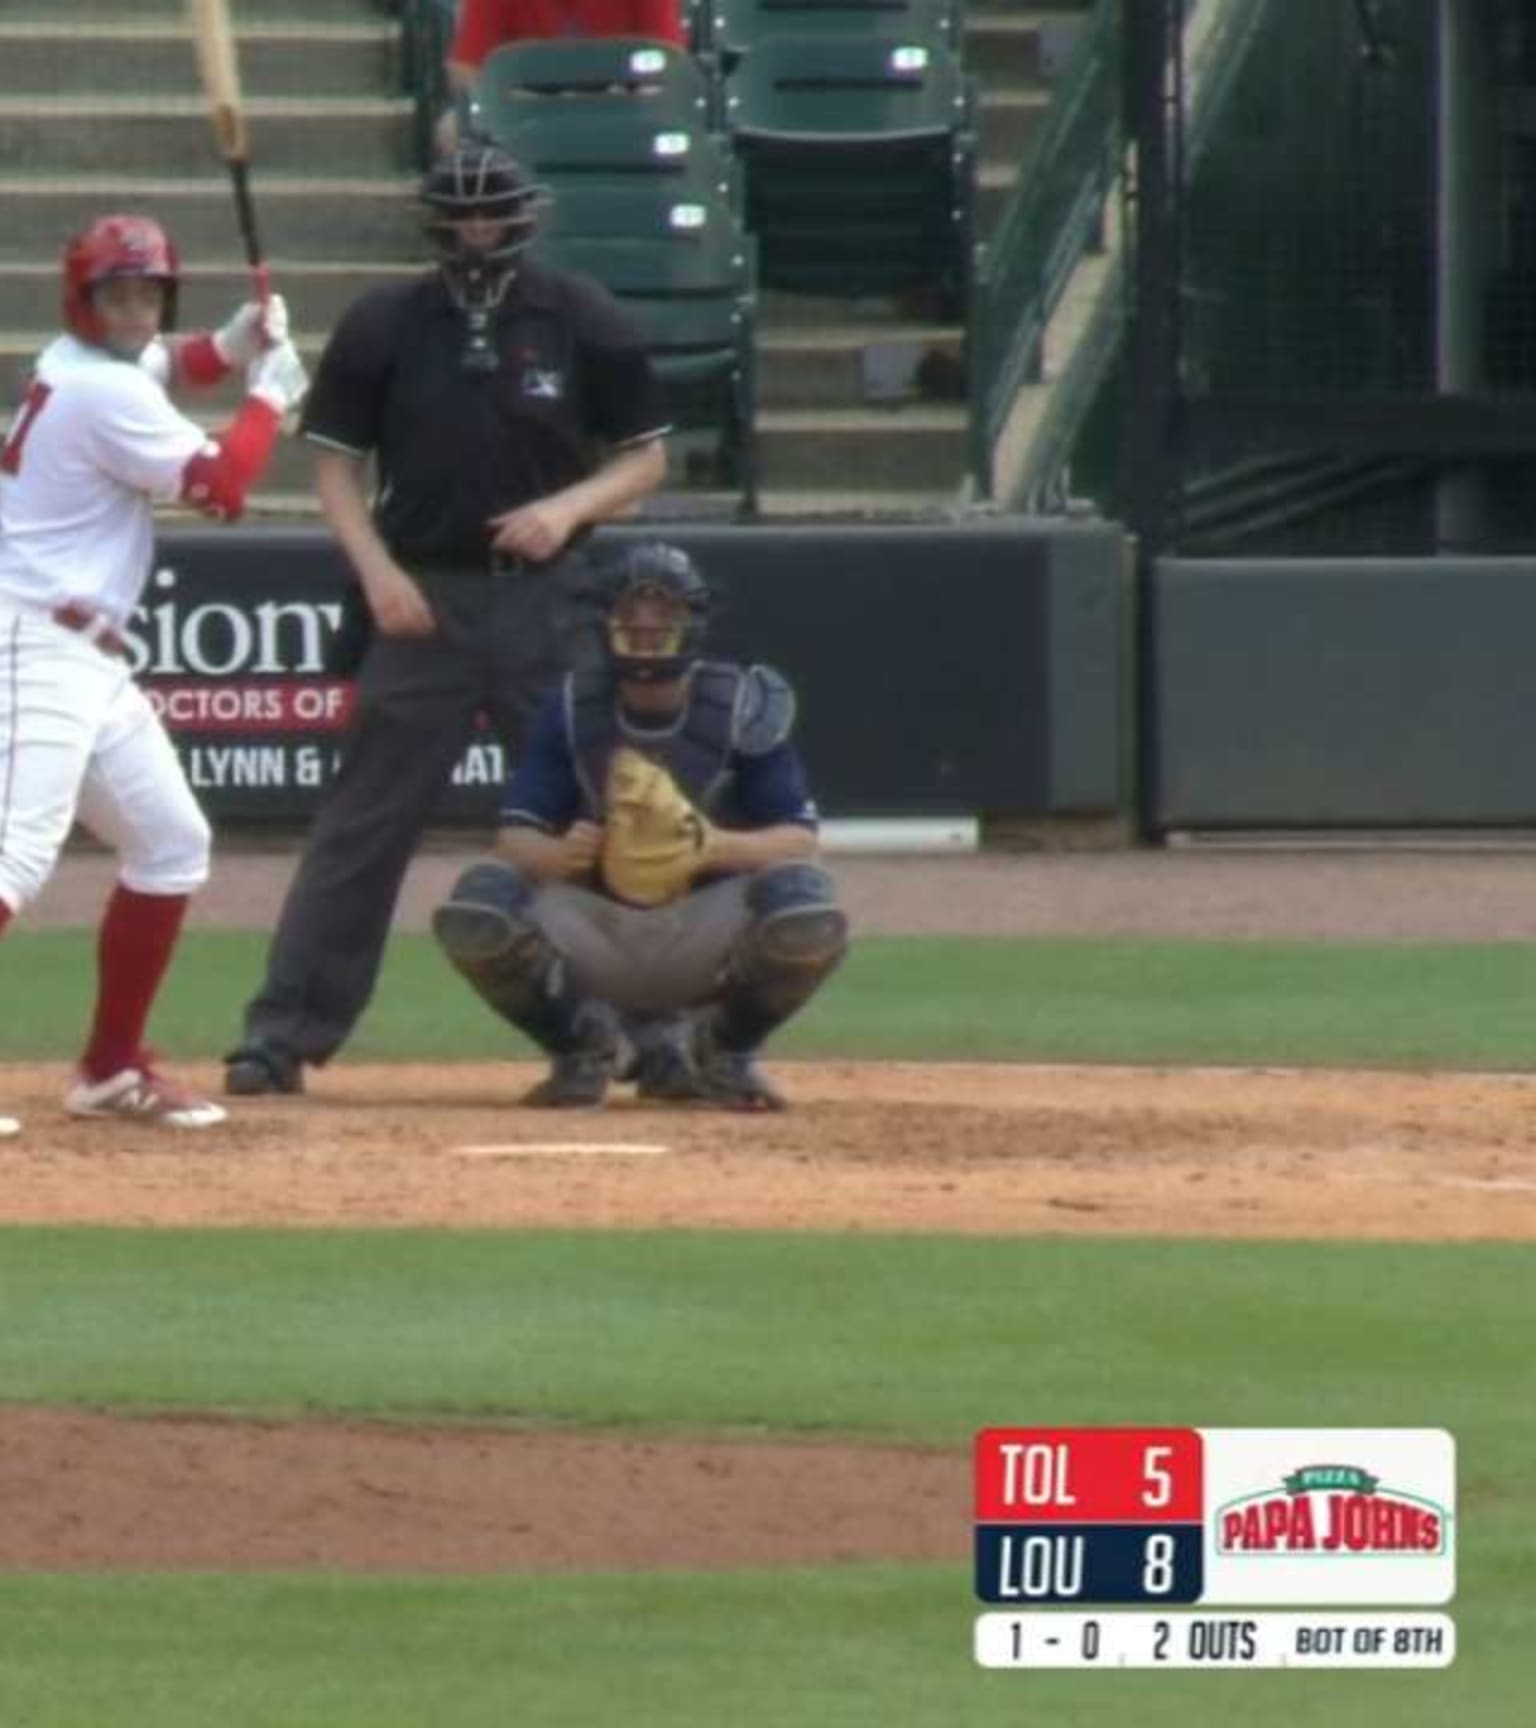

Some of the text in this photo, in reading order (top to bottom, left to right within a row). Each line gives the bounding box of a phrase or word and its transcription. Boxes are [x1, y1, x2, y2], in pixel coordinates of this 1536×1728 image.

[293, 689, 344, 720] OF
[190, 746, 285, 787] LYNN
[295, 746, 322, 787] &
